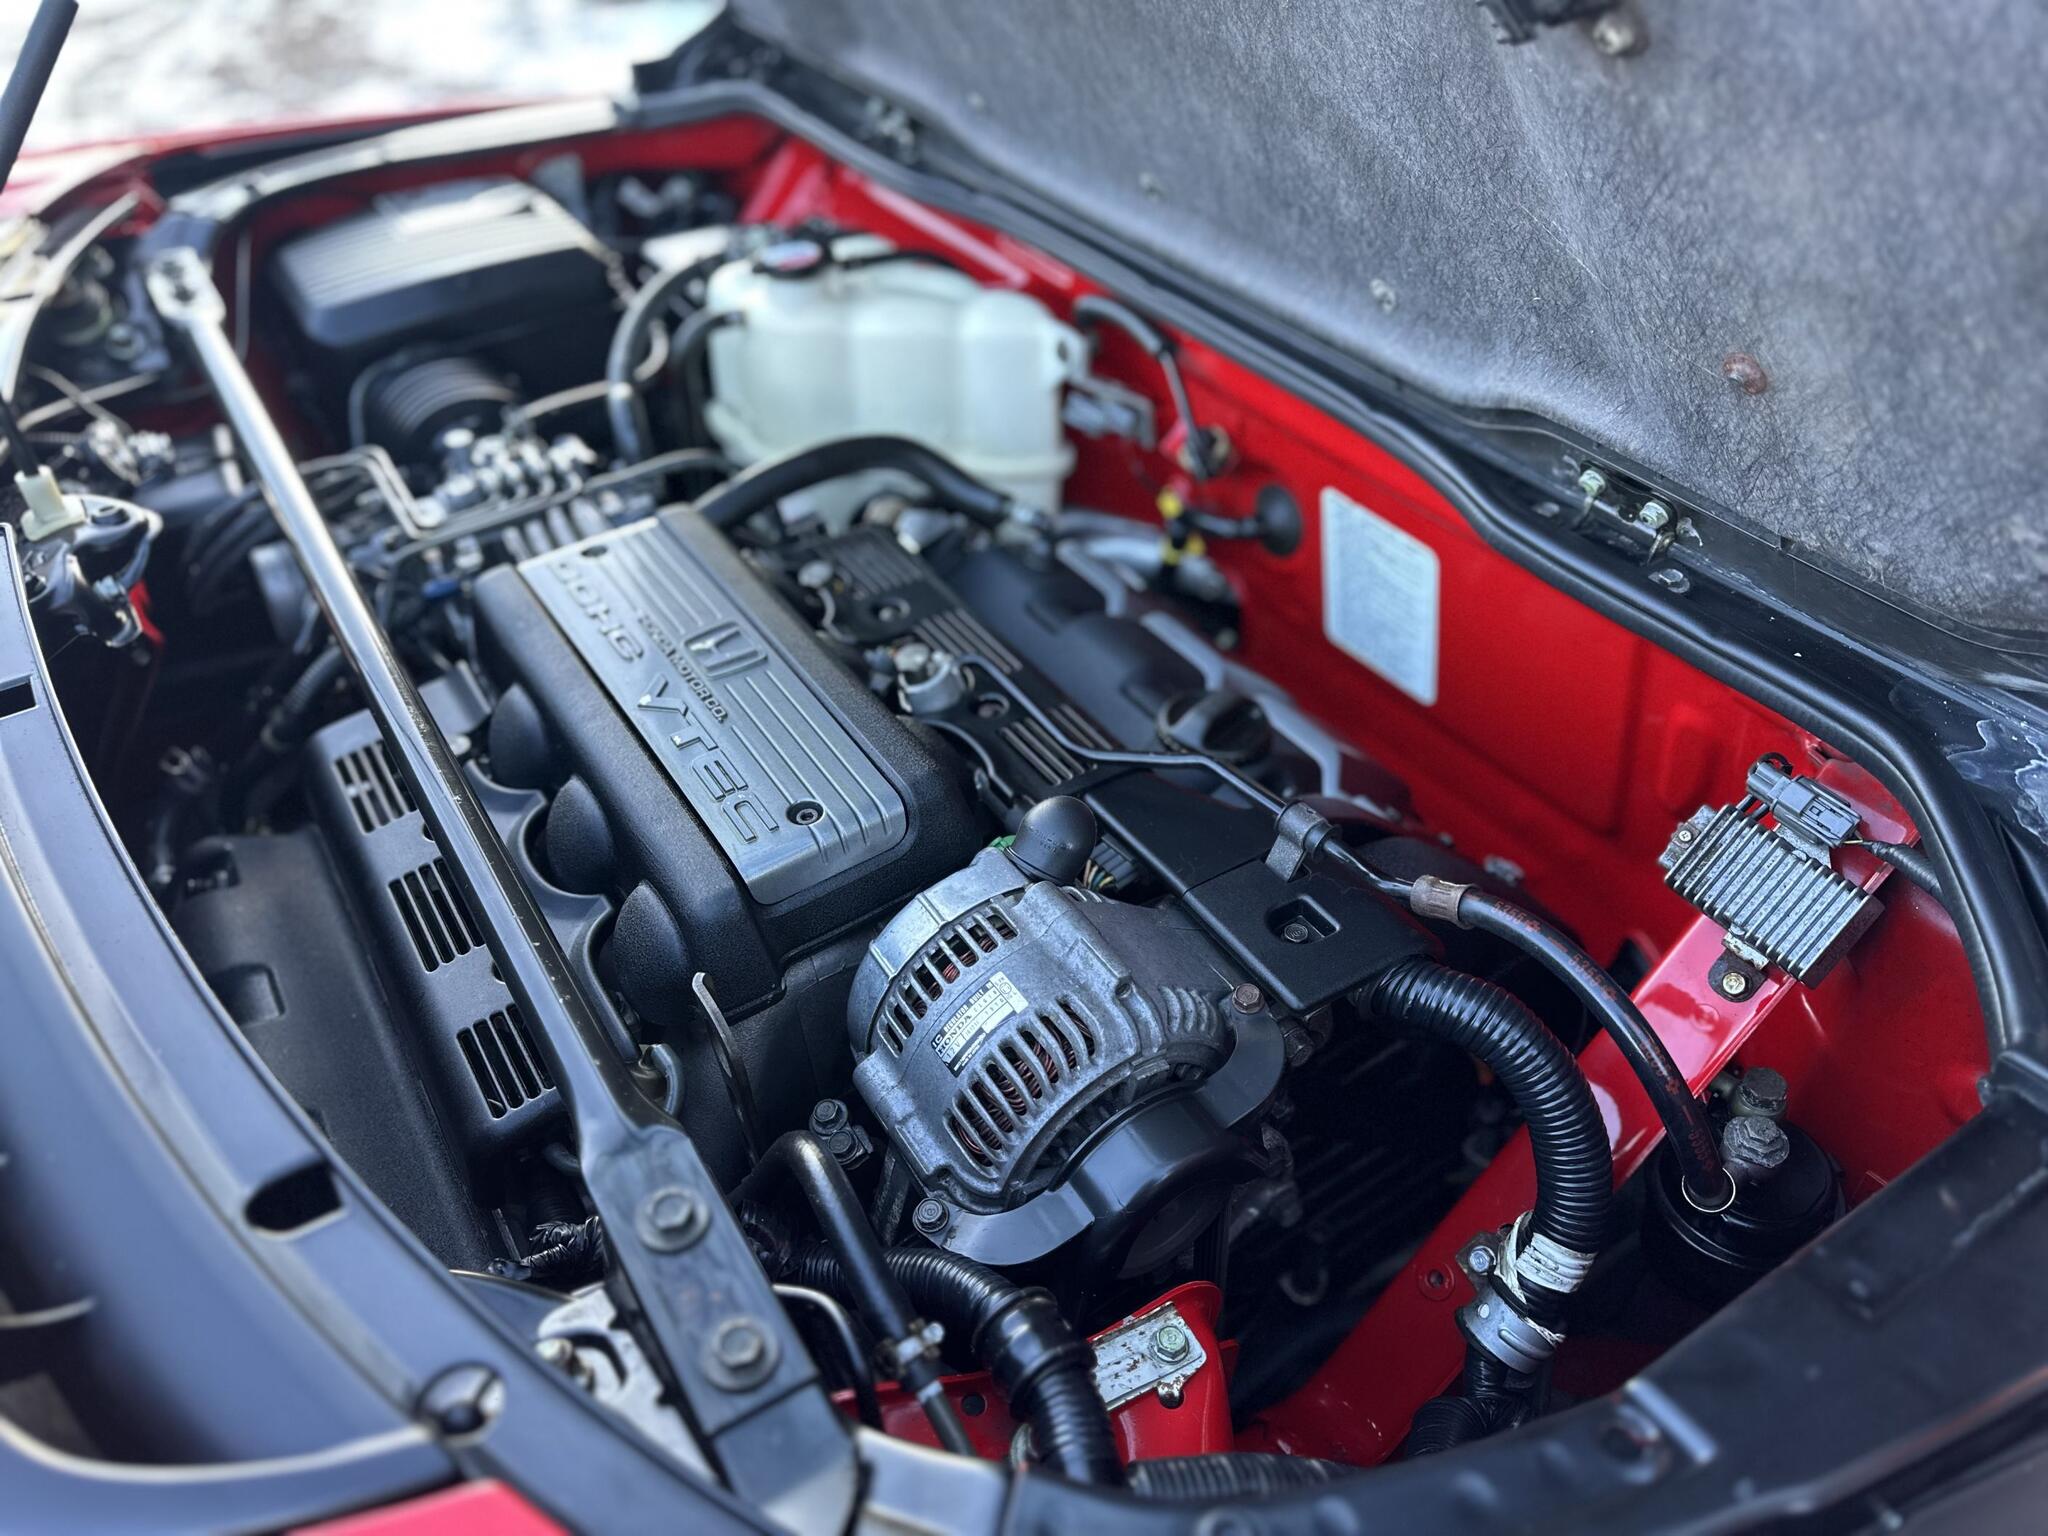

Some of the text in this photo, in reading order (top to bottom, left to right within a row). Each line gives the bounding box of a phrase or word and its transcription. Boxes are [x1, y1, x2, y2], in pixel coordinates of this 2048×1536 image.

[669, 653, 711, 700] MOTOR
[637, 673, 779, 845] VTEC
[931, 1033, 943, 1047] IC
[935, 1014, 972, 1054] HONDA
